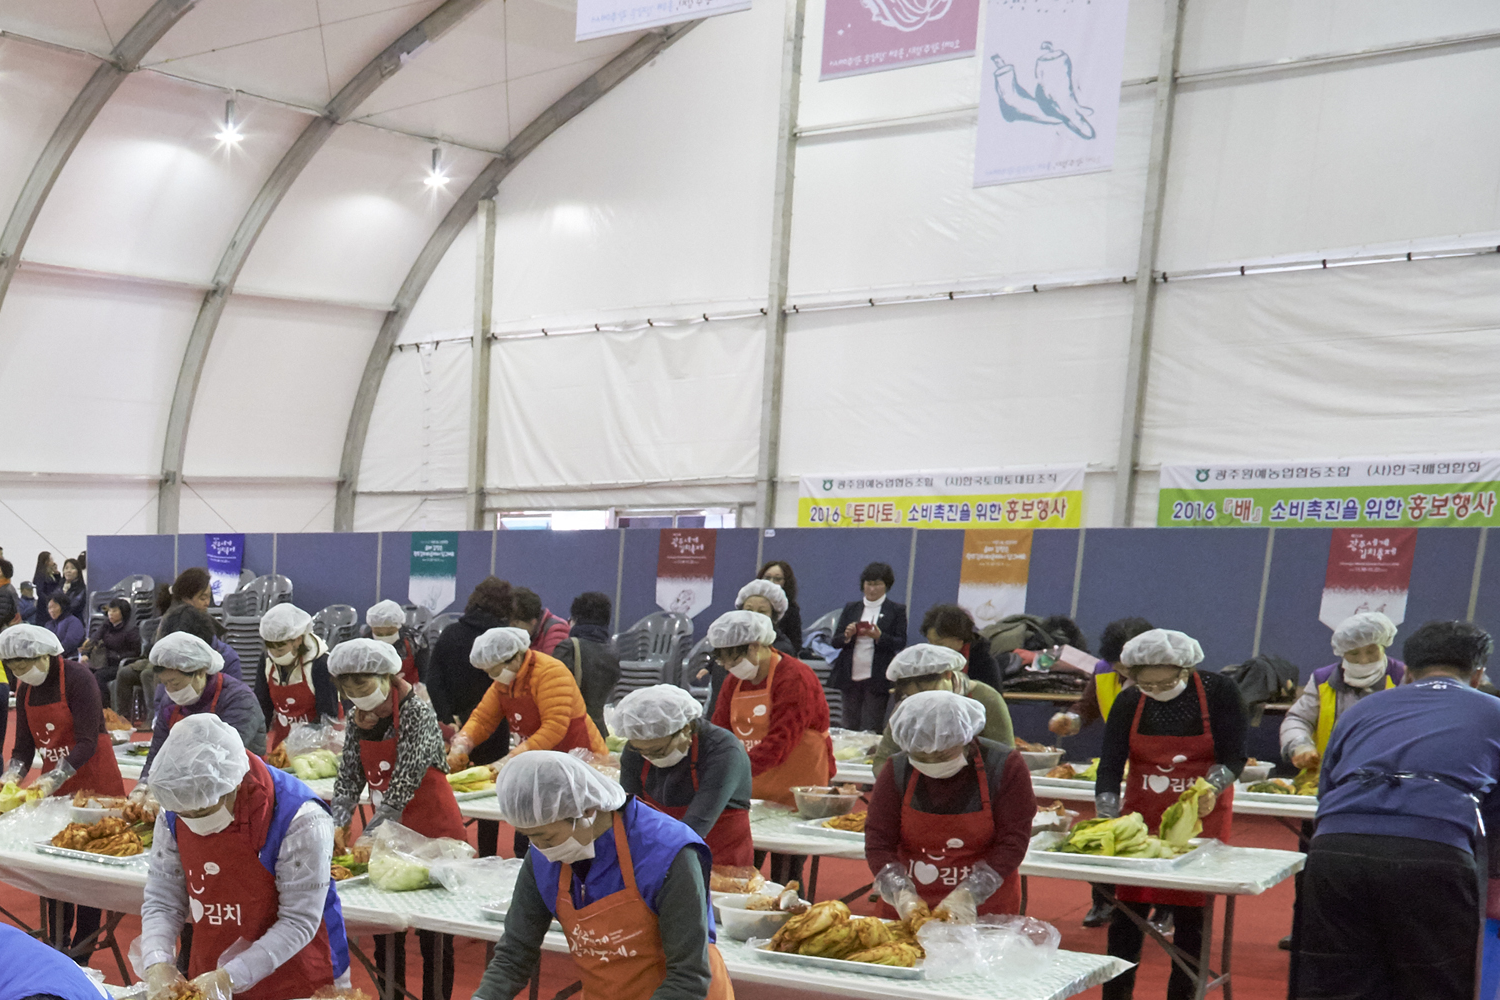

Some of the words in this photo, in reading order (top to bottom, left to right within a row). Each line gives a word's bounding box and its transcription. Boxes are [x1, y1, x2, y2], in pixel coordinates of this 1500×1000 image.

[1215, 466, 1351, 481] 광주원예농업협동조합
[810, 506, 840, 522] 2016
[908, 503, 971, 522] 소비촉진을
[976, 503, 1002, 521] 위한
[1006, 498, 1067, 522] 홍보행사
[1173, 502, 1215, 520] 2016
[1223, 499, 1262, 522] 『배』
[1270, 498, 1359, 521] 소비촉진을
[1365, 498, 1402, 519] 위한
[1408, 492, 1495, 520] 홍보행사
[1347, 538, 1390, 552] 광주세계
[1359, 547, 1397, 560] 김치축제
[46, 745, 70, 762] 김치
[204, 903, 241, 926] 김치
